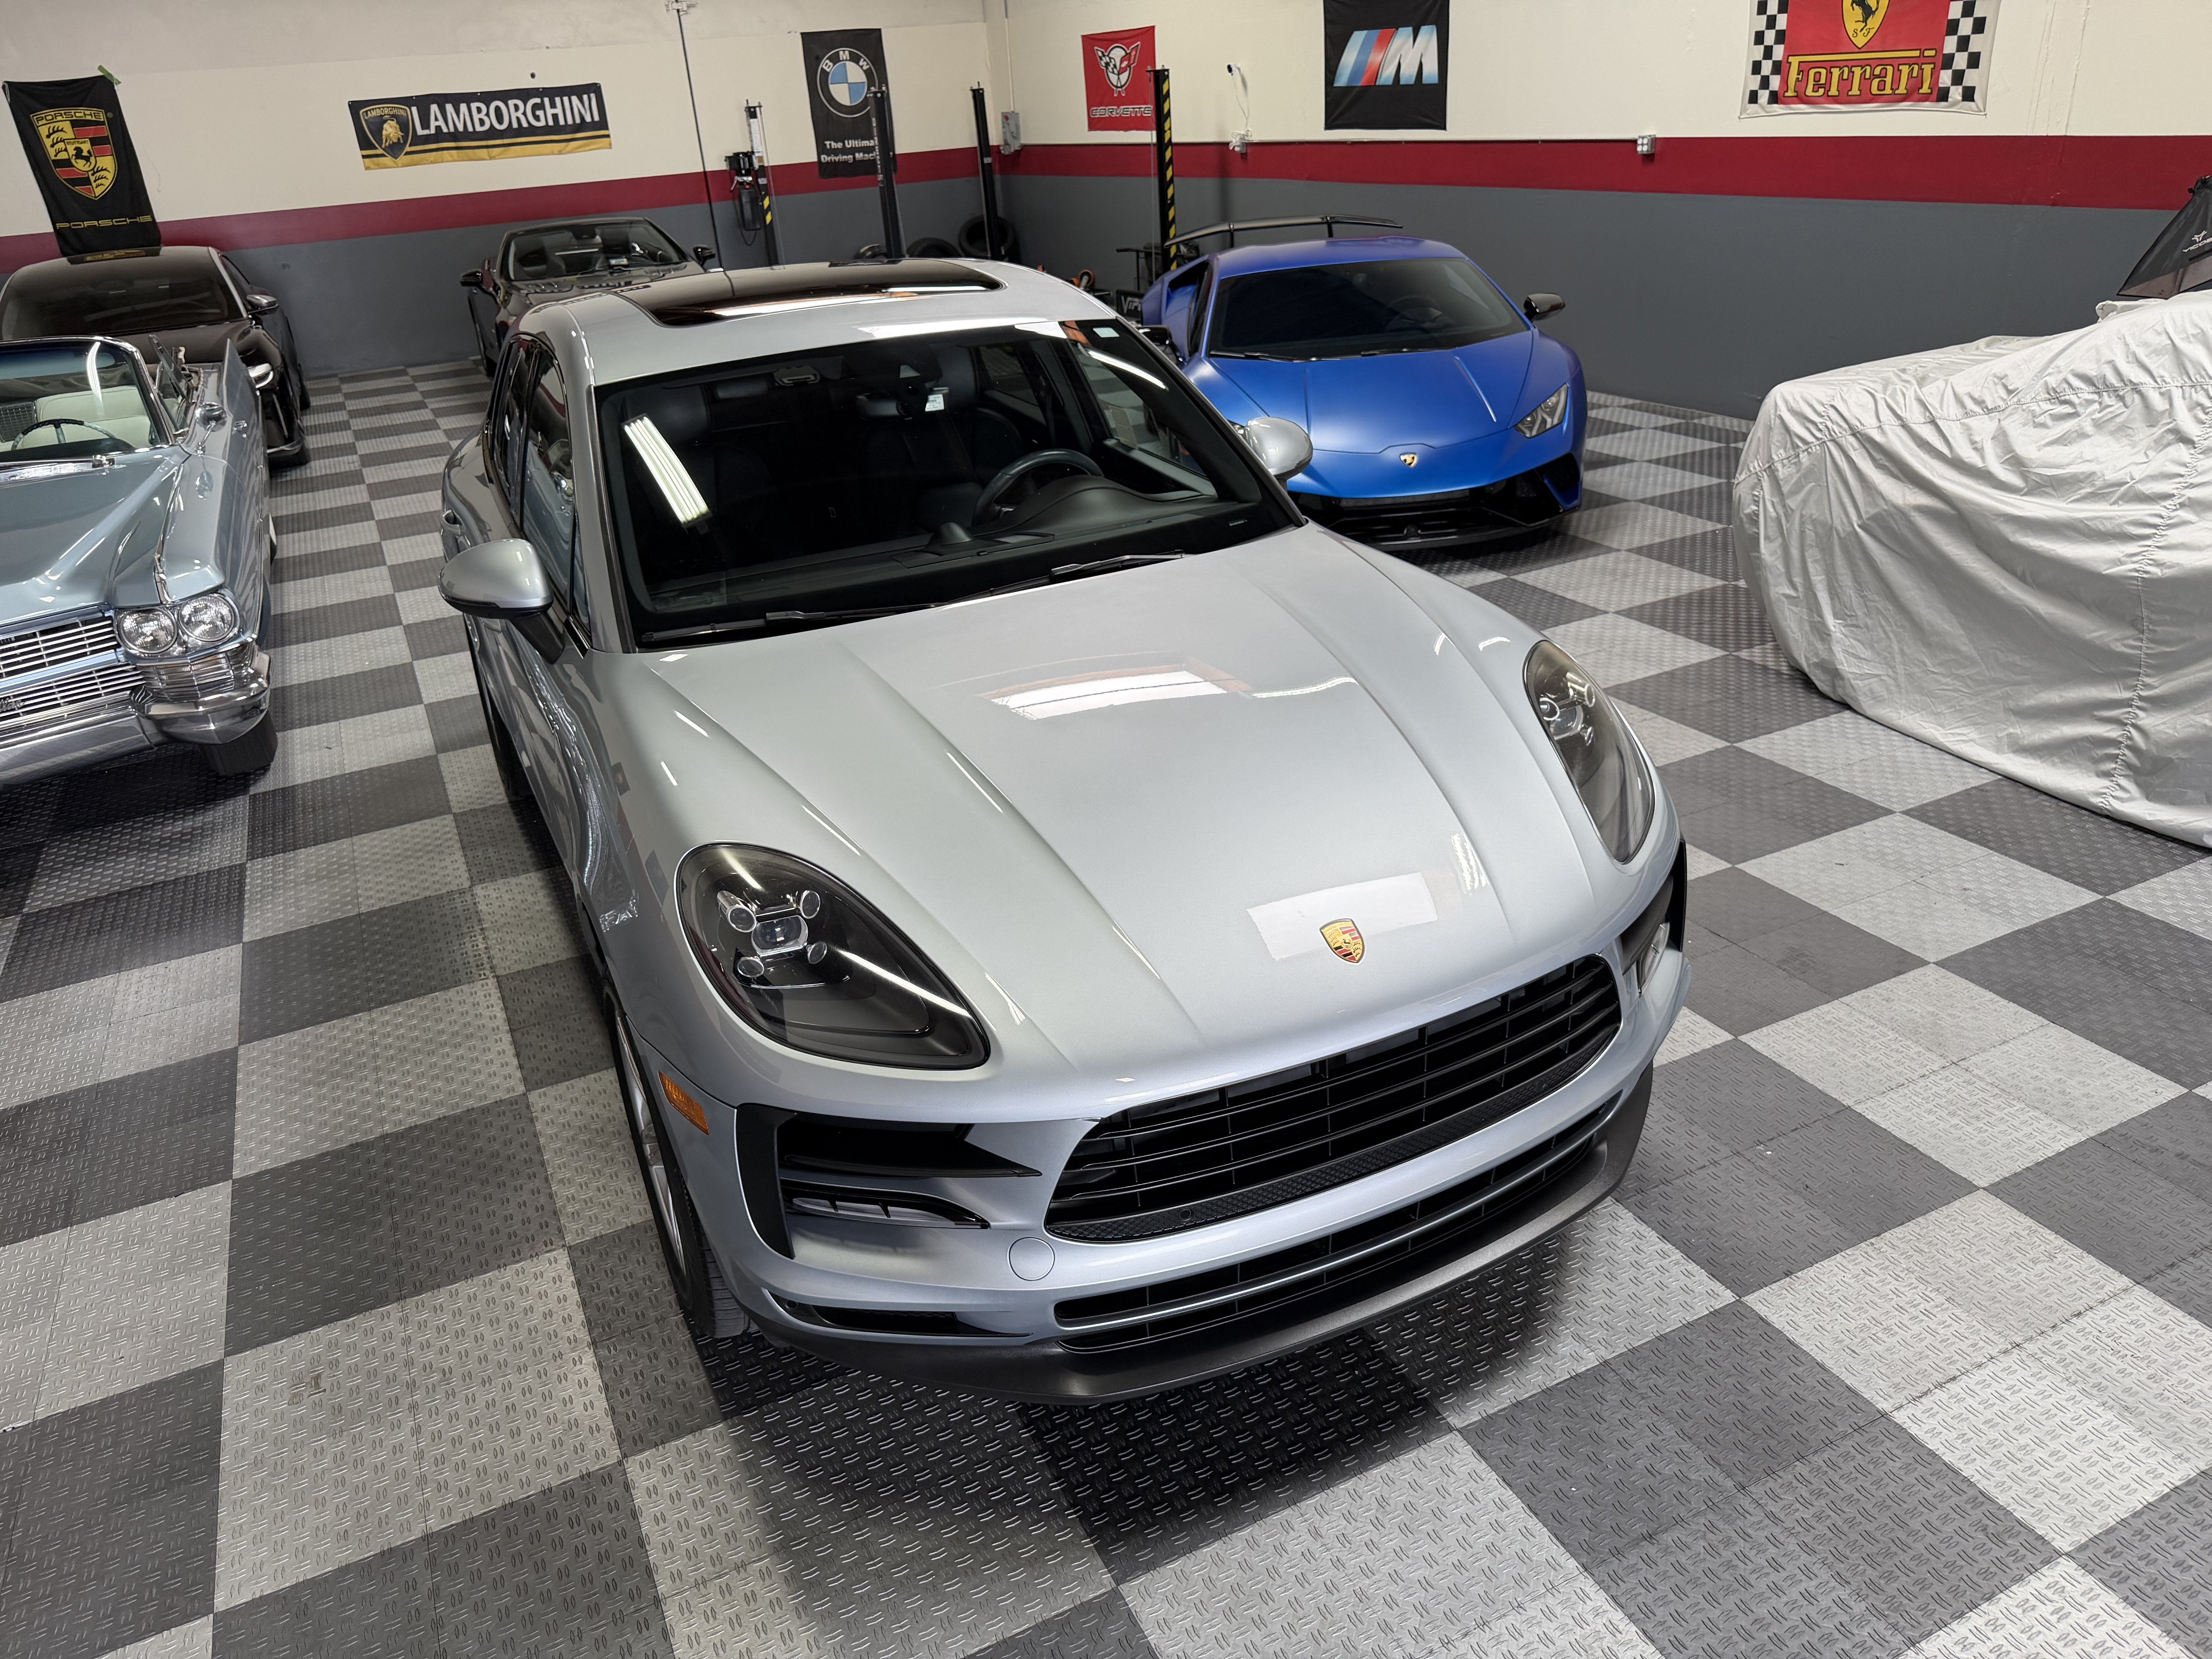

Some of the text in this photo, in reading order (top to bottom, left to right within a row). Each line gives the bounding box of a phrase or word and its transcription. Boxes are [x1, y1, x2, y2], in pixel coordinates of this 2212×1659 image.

[822, 50, 870, 72] BMW
[1783, 48, 1937, 98] Ferrari
[36, 111, 102, 124] PORSCHE
[364, 107, 407, 119] LAMBORGHINI
[411, 93, 600, 136] LAMBORGHINI
[1090, 105, 1152, 117] CORVETTE
[824, 141, 843, 149] The
[821, 154, 854, 163] Driving
[56, 215, 153, 229] PORSCHE
